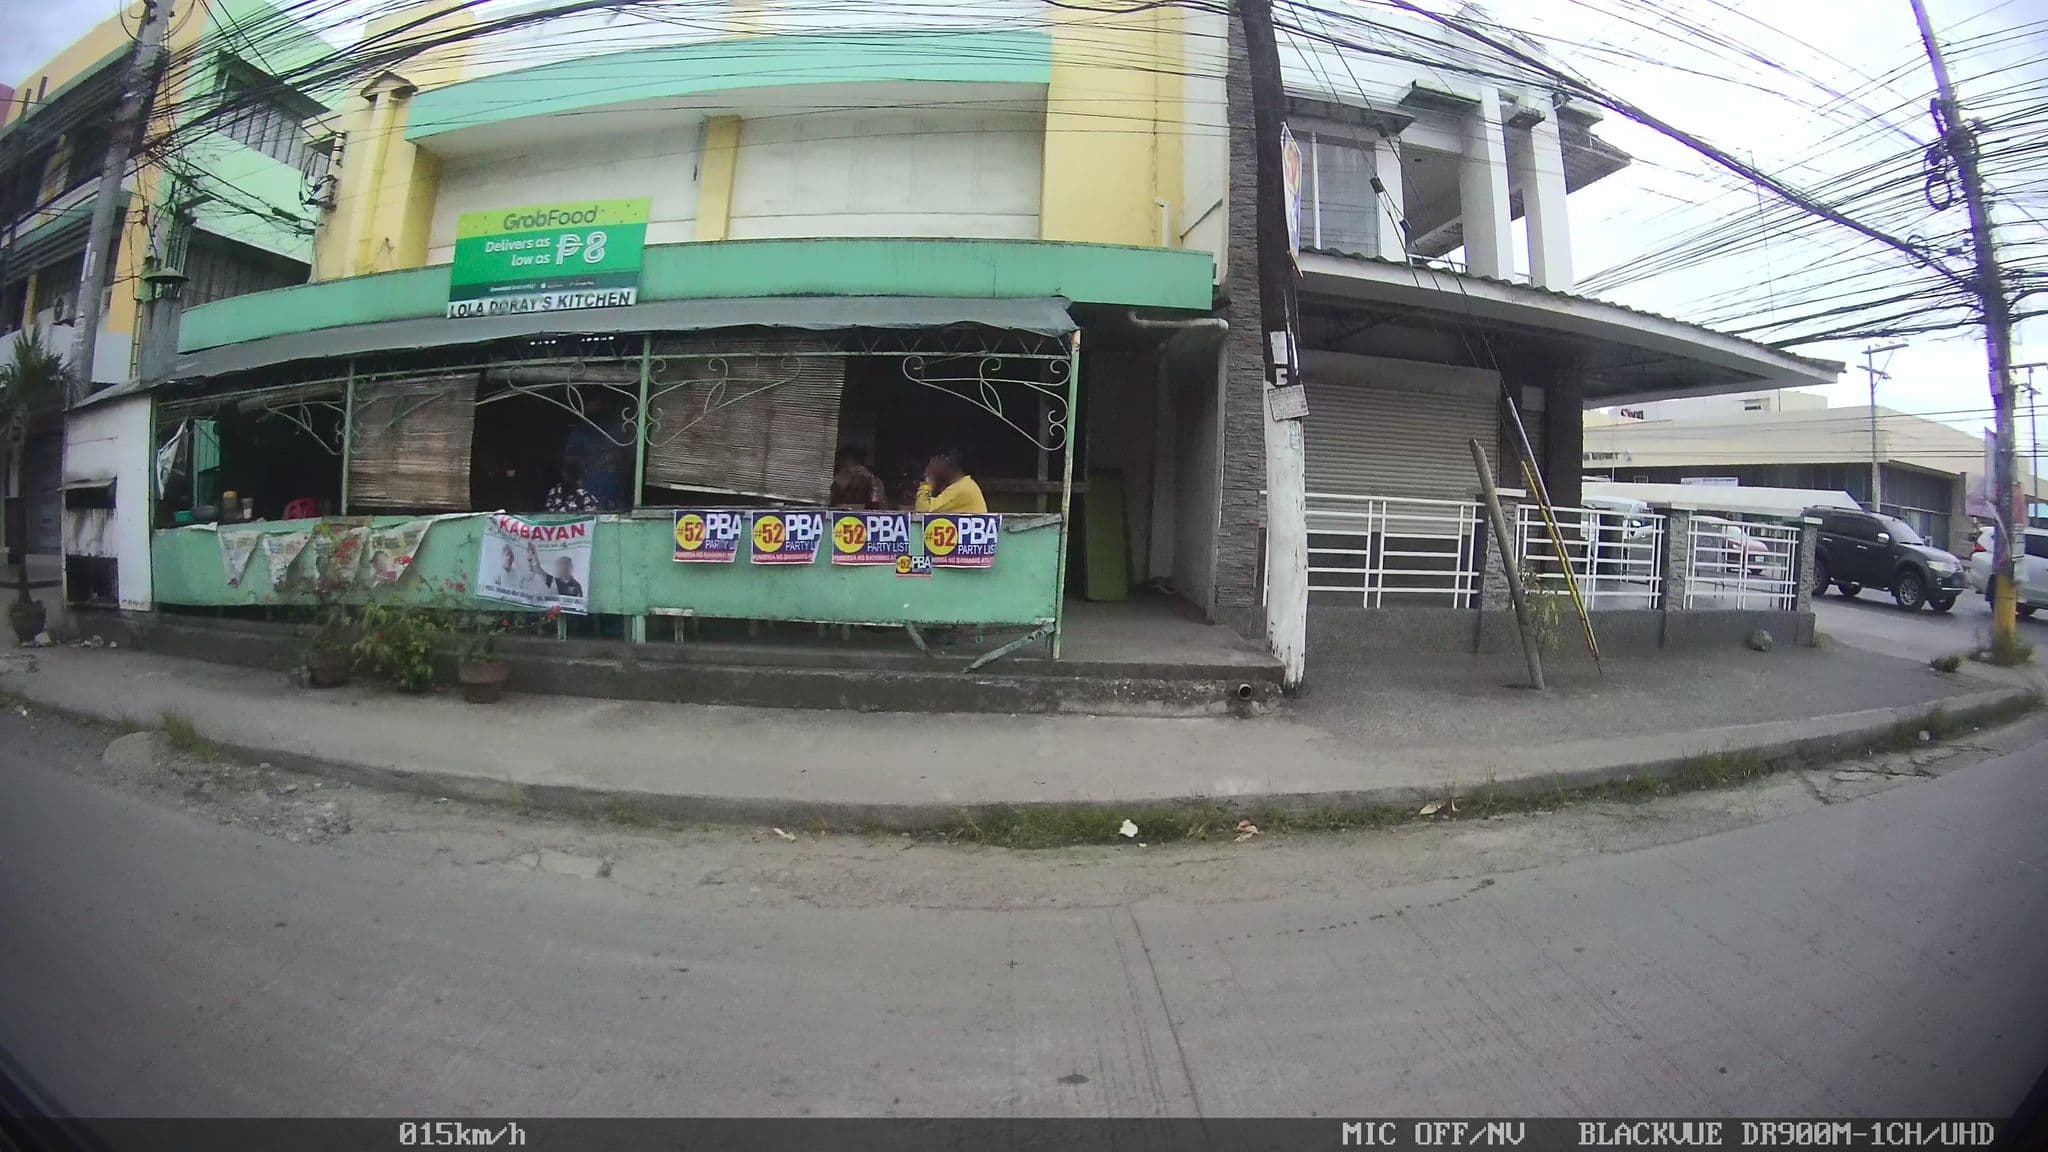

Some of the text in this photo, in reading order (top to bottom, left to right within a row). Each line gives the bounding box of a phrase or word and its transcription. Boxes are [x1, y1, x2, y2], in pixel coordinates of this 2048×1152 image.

[503, 205, 598, 231] GrabFood
[485, 238, 551, 253] Delivers as
[511, 253, 551, 267] low as
[556, 290, 631, 308] KITCHEN
[499, 516, 585, 541] KABAYAN
[676, 513, 742, 542] #52 PBA
[754, 514, 823, 544] #52 PBA
[834, 515, 909, 545] #52 PBA
[925, 517, 998, 547] #52 PBA
[785, 541, 809, 551] PARTY
[867, 542, 910, 552] PARTY LIST
[957, 544, 983, 555] PARTY
[911, 556, 931, 569] PBA
